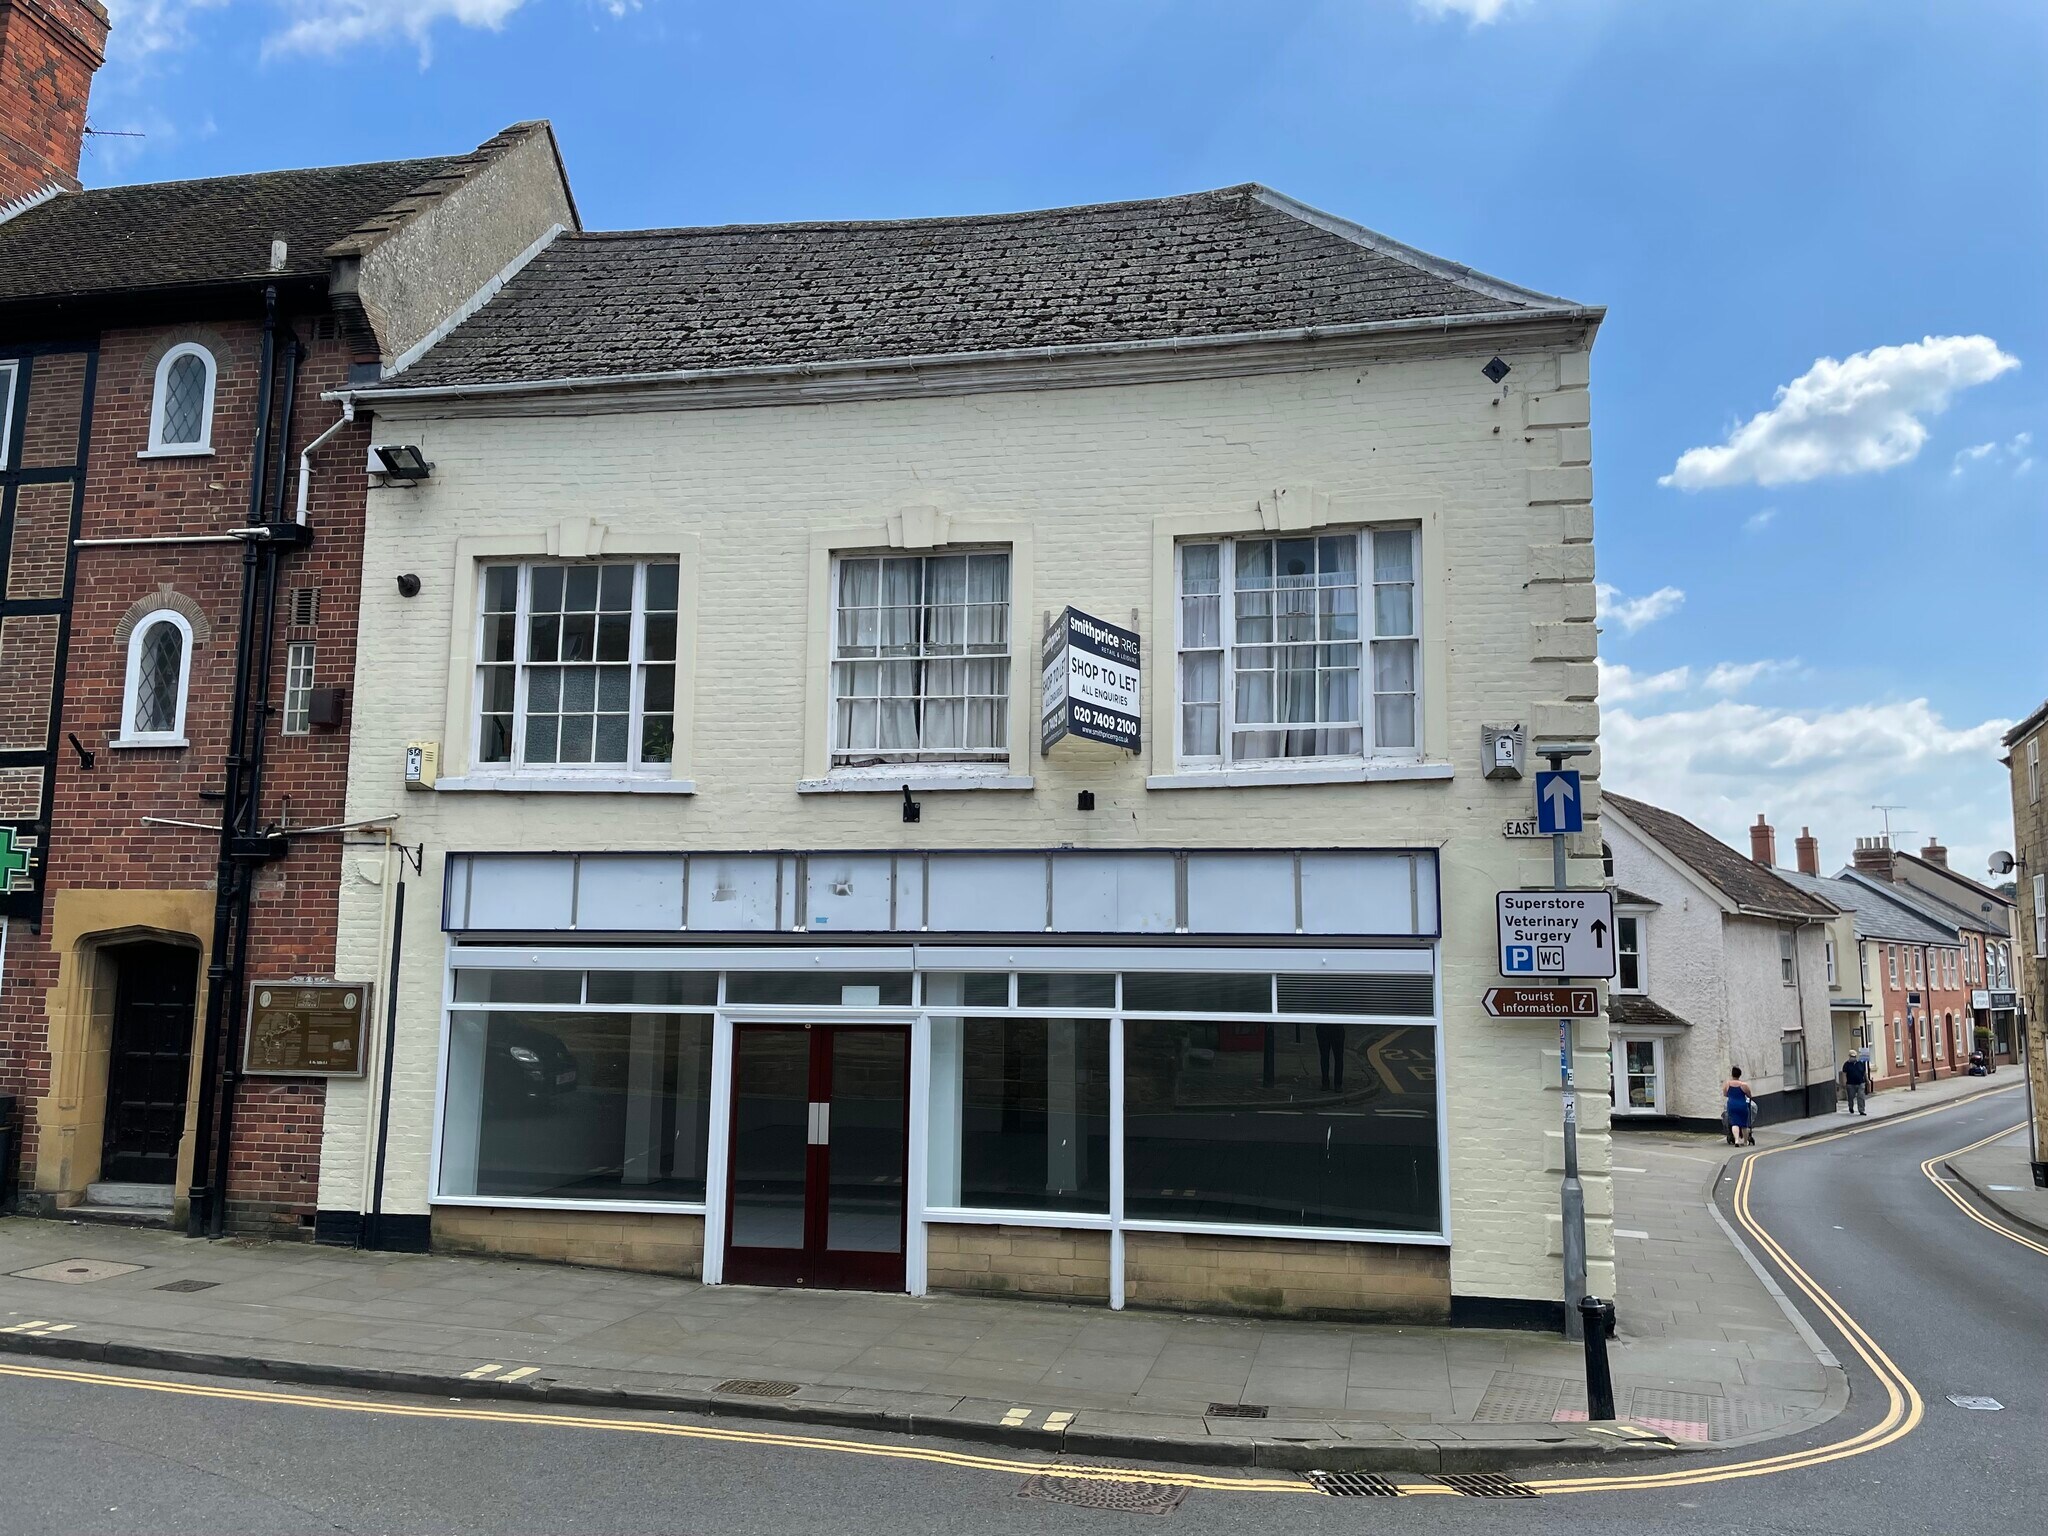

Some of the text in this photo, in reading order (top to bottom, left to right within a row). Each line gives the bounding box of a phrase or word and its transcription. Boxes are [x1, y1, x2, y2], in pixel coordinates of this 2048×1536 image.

[1070, 617, 1119, 647] smithprice
[1101, 646, 1116, 657] RETAIL
[1120, 653, 1137, 664] LEISURE
[1071, 656, 1137, 693] SHOP TO LET
[1081, 684, 1128, 706] ALL ENQUIRIES
[1074, 705, 1137, 736] 020 7409 2100
[1506, 822, 1537, 835] EAST
[1504, 897, 1585, 910] Superstore
[1504, 915, 1579, 929] Veterinary
[1514, 929, 1572, 943] Surgery
[1512, 948, 1561, 968] P WC
[1514, 991, 1554, 1001] Tourist
[1502, 1002, 1569, 1013] information
